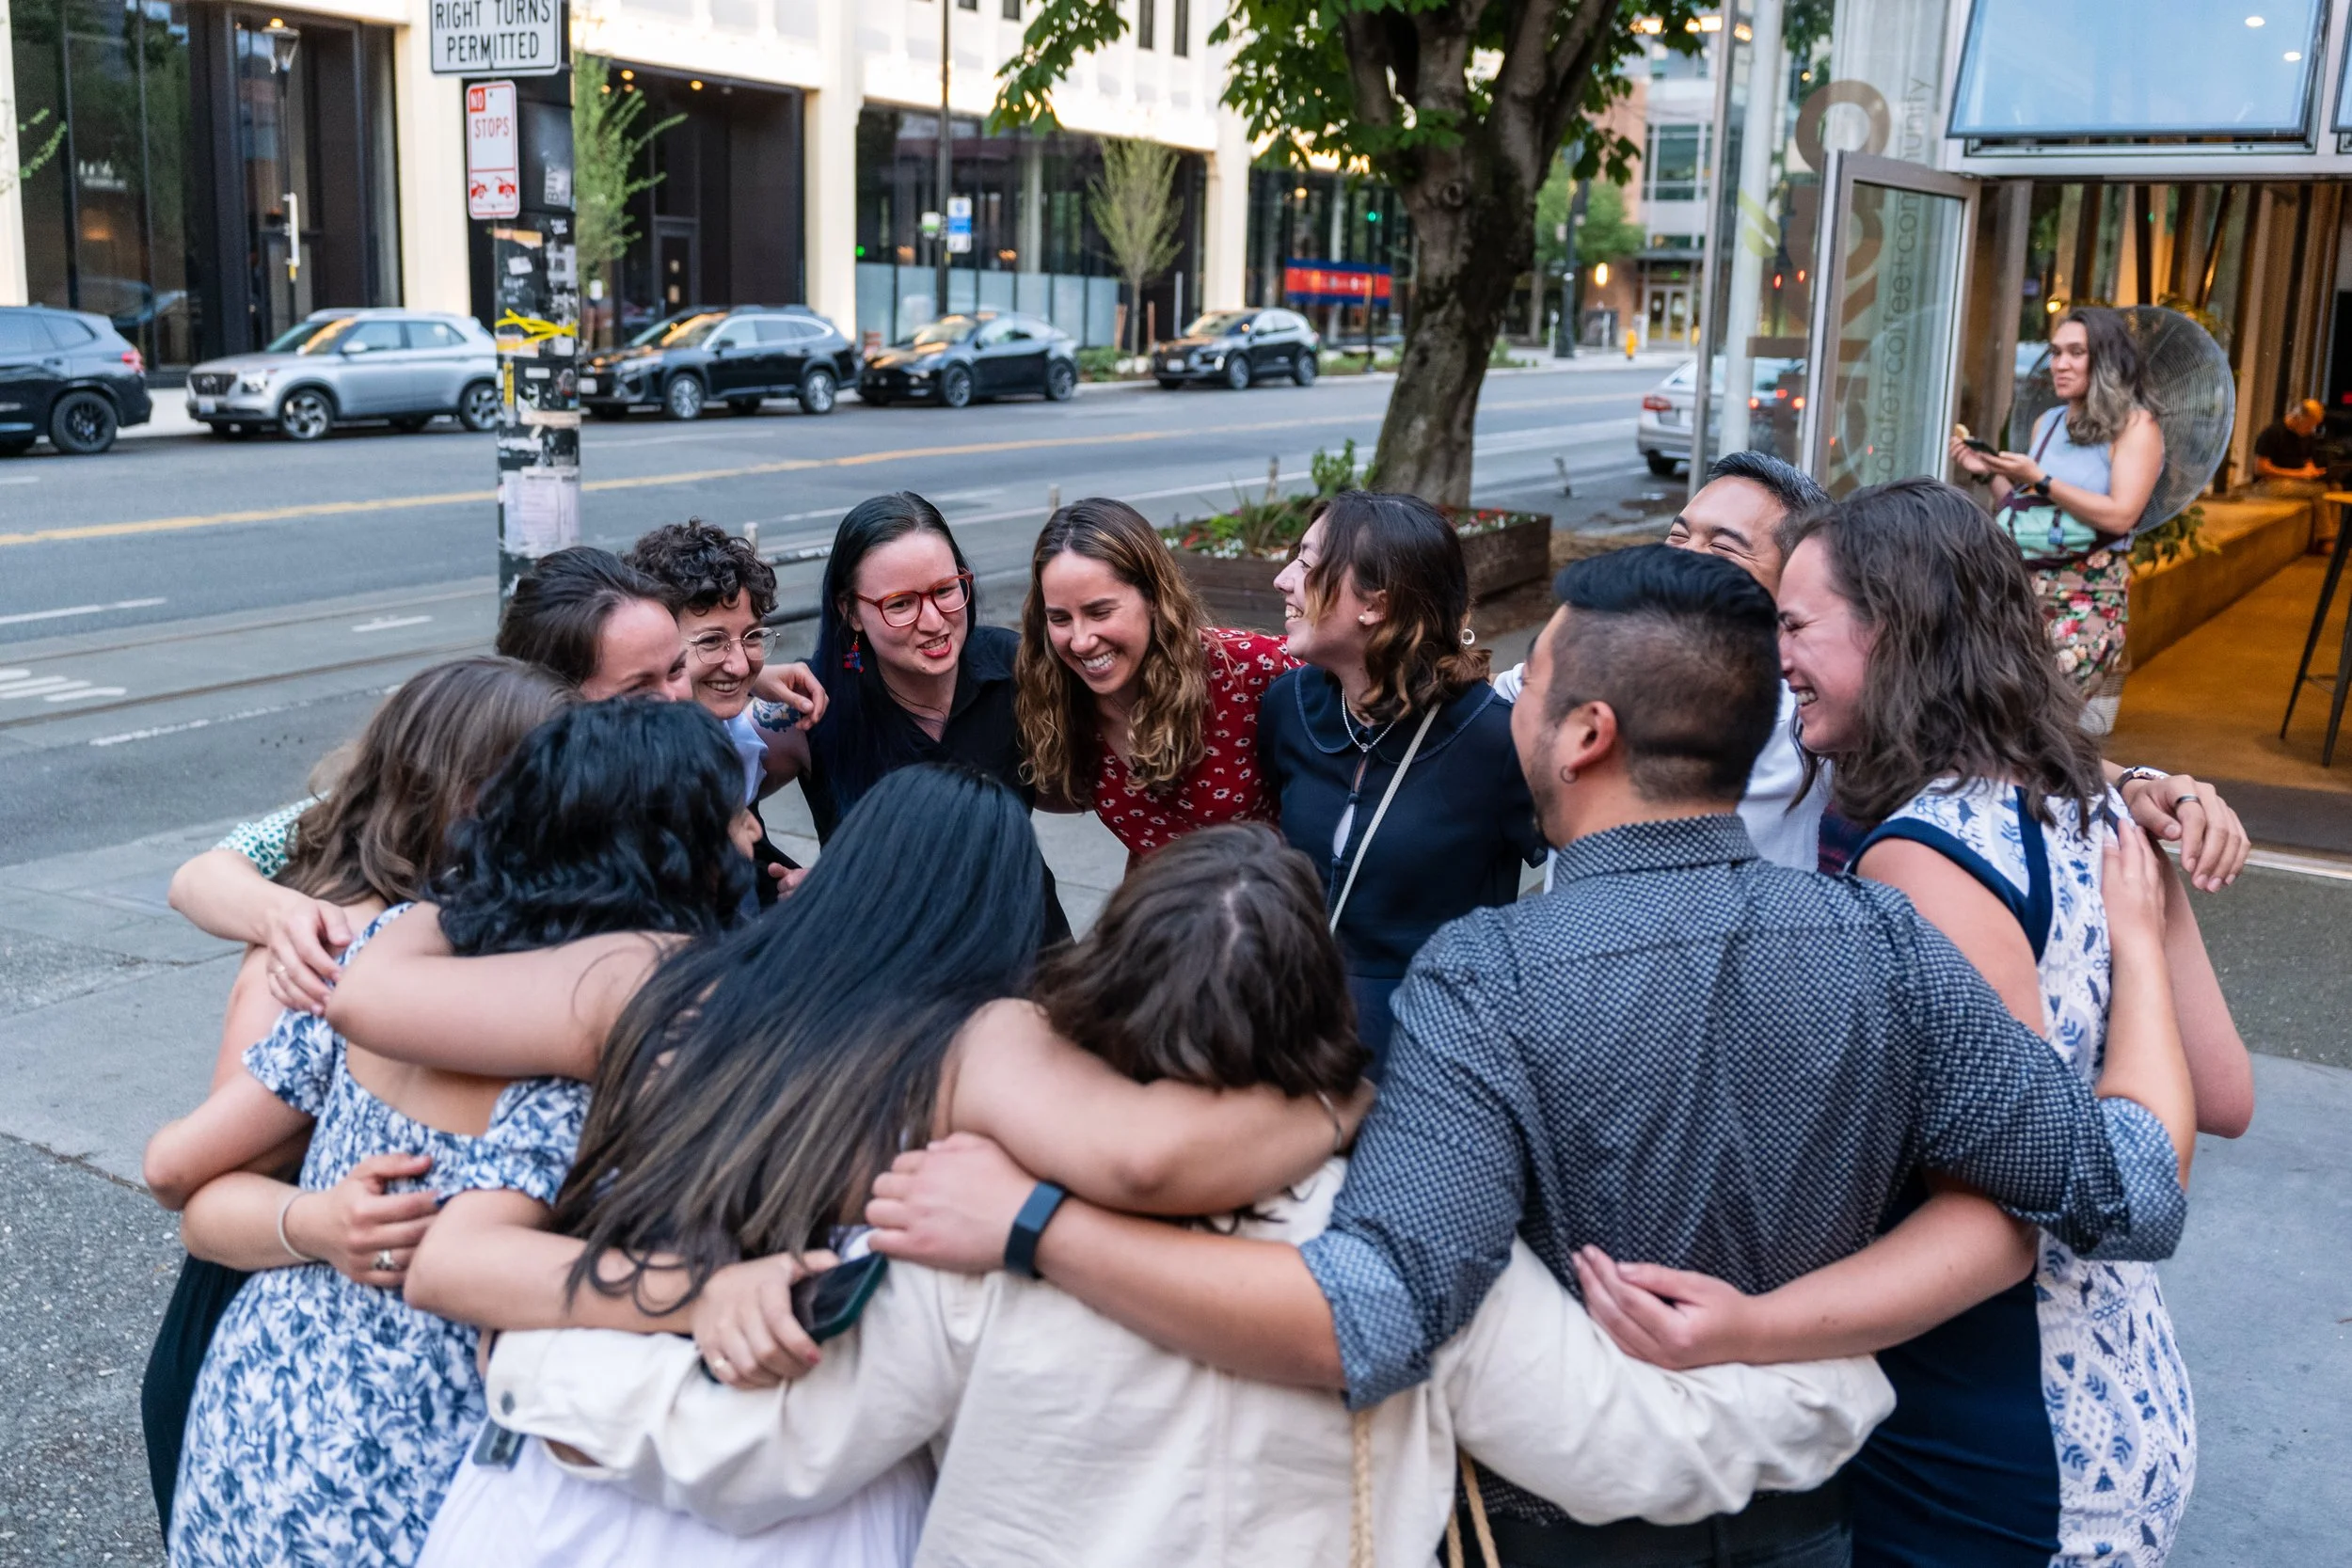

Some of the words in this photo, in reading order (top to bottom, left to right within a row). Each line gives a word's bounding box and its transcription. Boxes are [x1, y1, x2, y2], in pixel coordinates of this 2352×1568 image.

[436, 1, 482, 29] RIGHT
[495, 0, 550, 25] TURNS
[447, 31, 540, 62] PERMITTED
[469, 89, 485, 109] NO
[474, 117, 510, 139] STOPS
